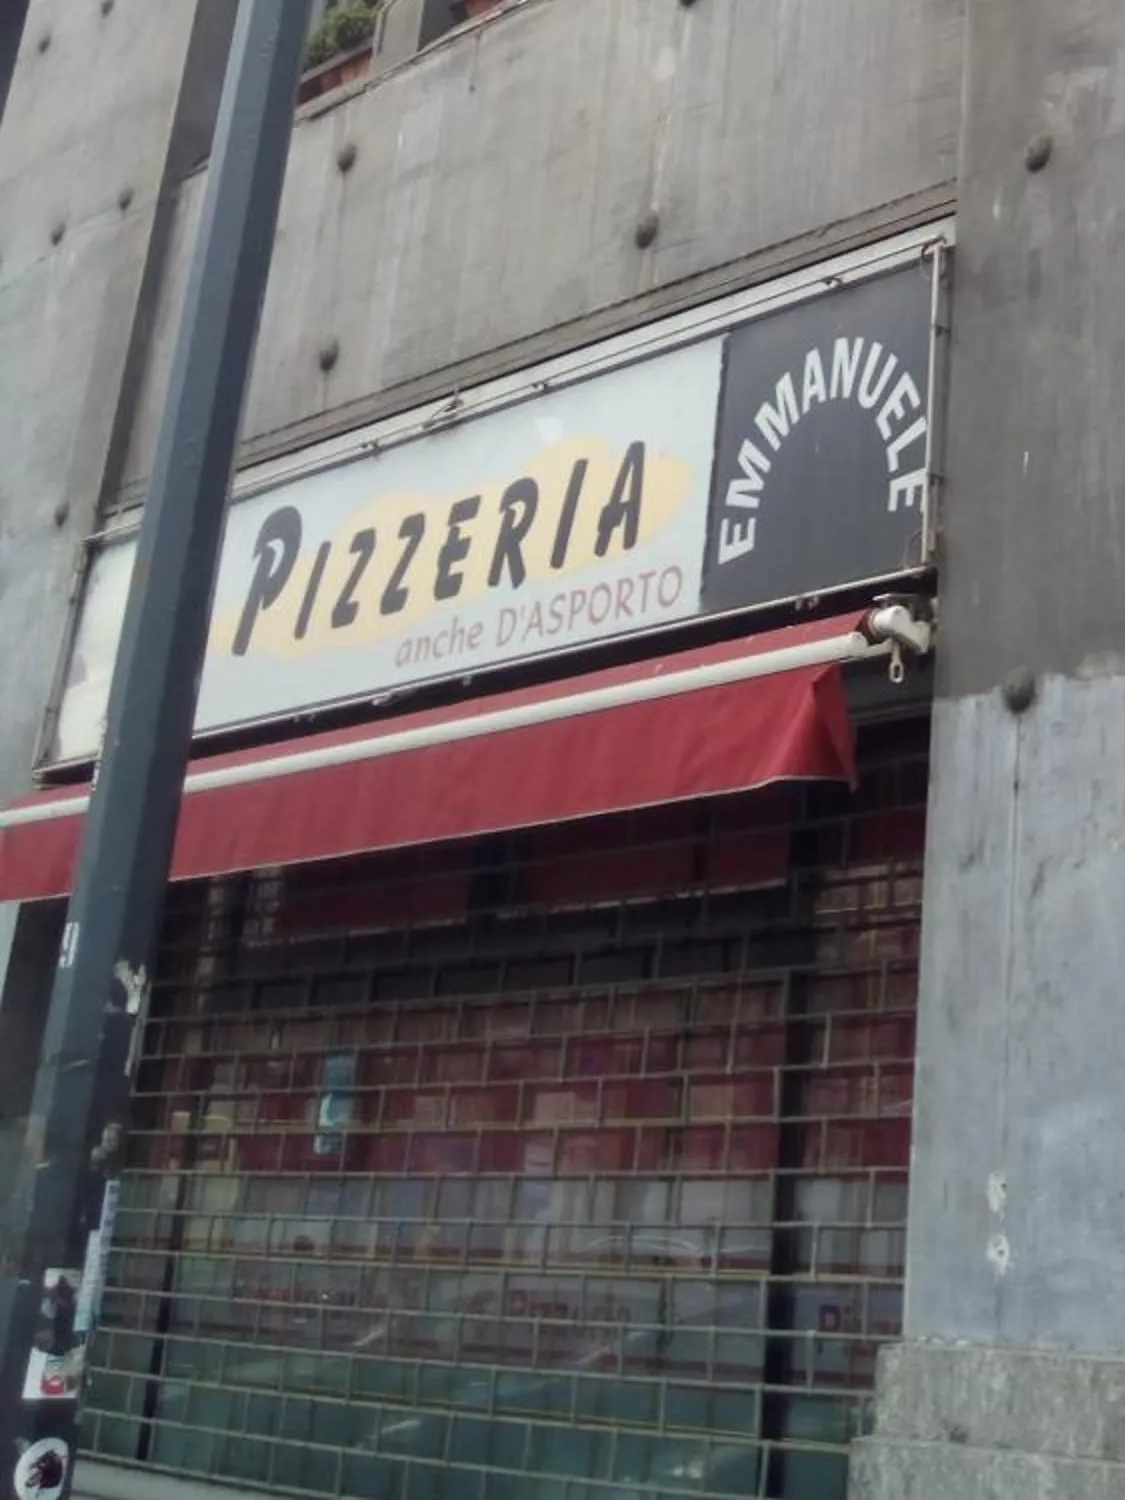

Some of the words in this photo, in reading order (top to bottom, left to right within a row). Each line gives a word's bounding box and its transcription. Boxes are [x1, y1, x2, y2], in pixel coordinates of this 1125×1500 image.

[231, 441, 647, 657] PIZZERIA
[717, 336, 928, 566] EMMANUELE
[394, 617, 484, 668] anche
[496, 564, 684, 648] D'ASPORTO
